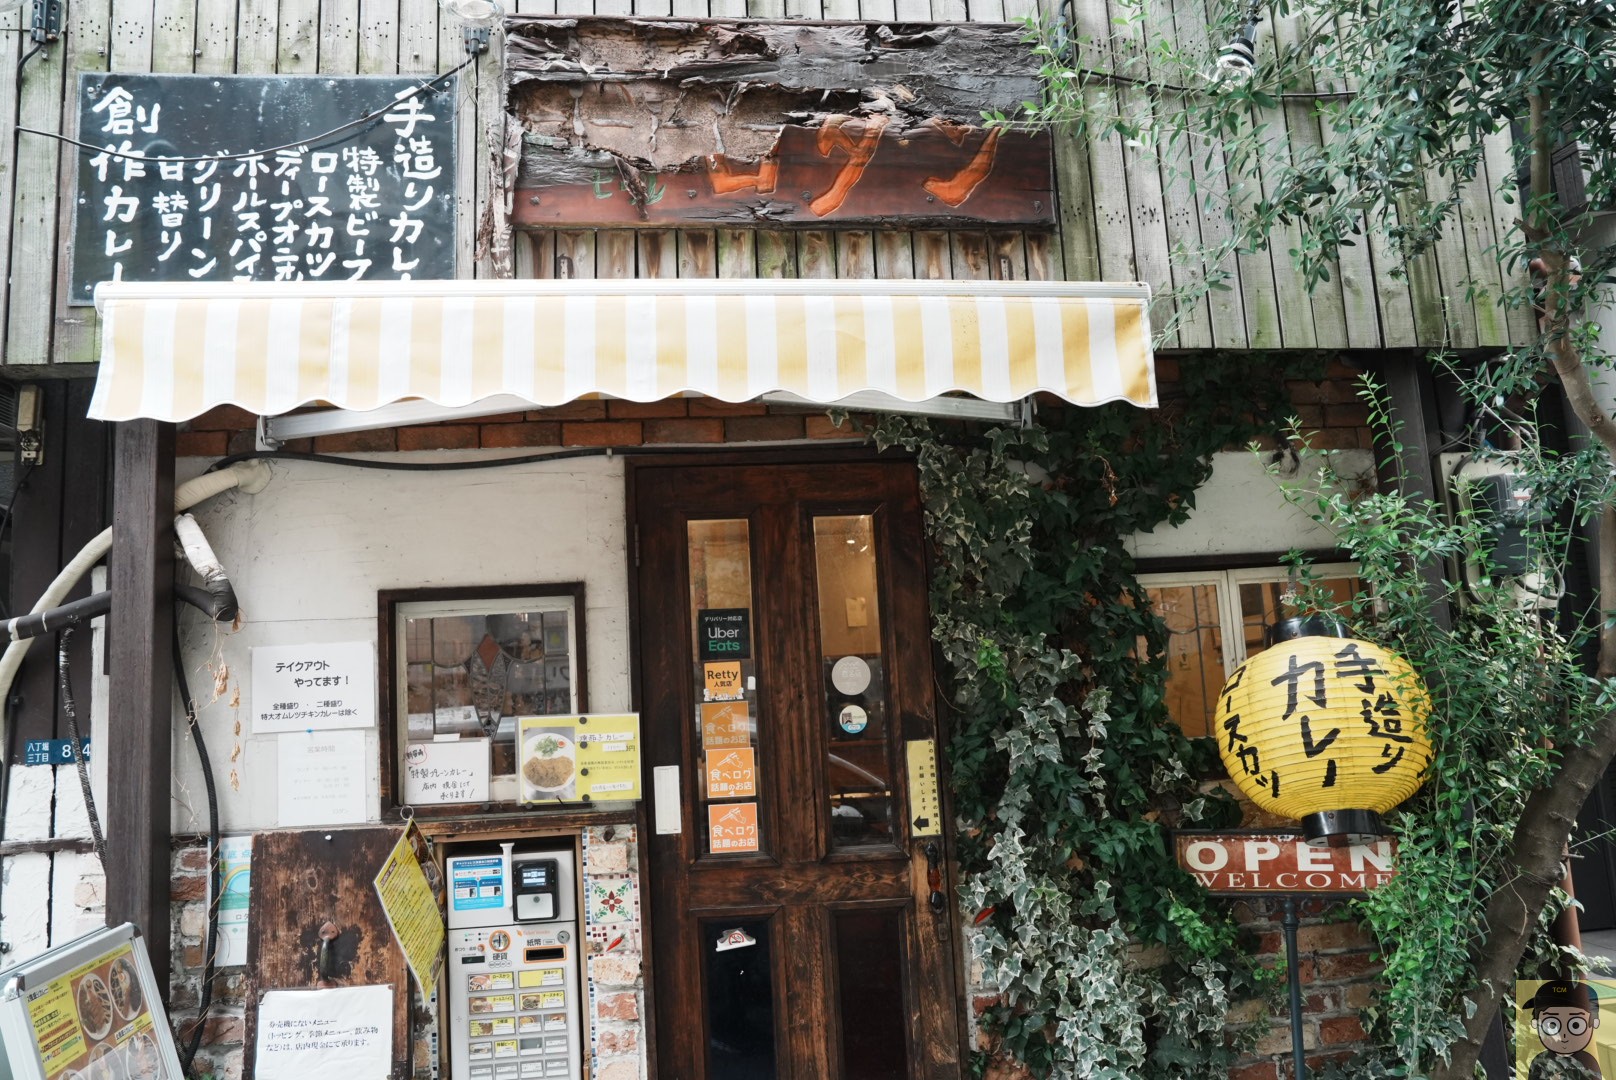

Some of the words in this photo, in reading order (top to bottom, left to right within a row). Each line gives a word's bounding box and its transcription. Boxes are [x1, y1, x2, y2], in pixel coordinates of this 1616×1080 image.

[383, 86, 443, 281] 手造りカレ
[153, 155, 188, 261] 日替り
[189, 149, 230, 278] グリーン
[270, 145, 309, 281] ディープオニオ
[304, 152, 338, 277] ロースカツ
[342, 146, 384, 281] 特製ビーフ
[229, 149, 270, 281] ホールスパイ
[708, 627, 740, 639] Uber
[708, 640, 741, 652] Eats
[275, 660, 330, 673] テイクアウト
[293, 675, 349, 688] やってます！
[707, 670, 739, 681] Retty
[272, 702, 300, 710] 全種盛り
[316, 700, 343, 708] 二種盛り
[1333, 643, 1415, 774] 手造り
[260, 708, 358, 721] 特大オムレツチキンカレーは除く
[1270, 654, 1341, 788] カレー
[27, 742, 50, 752] 八丁堀
[27, 753, 50, 763] 三丁目
[709, 768, 753, 782] 食べログ
[710, 782, 753, 793] 話題のお店
[711, 824, 755, 838] 食べログ
[712, 838, 757, 849] 話題のお店
[1185, 841, 1394, 872] OPEN
[526, 938, 542, 947] 紙幣
[492, 952, 508, 961] 硬貨
